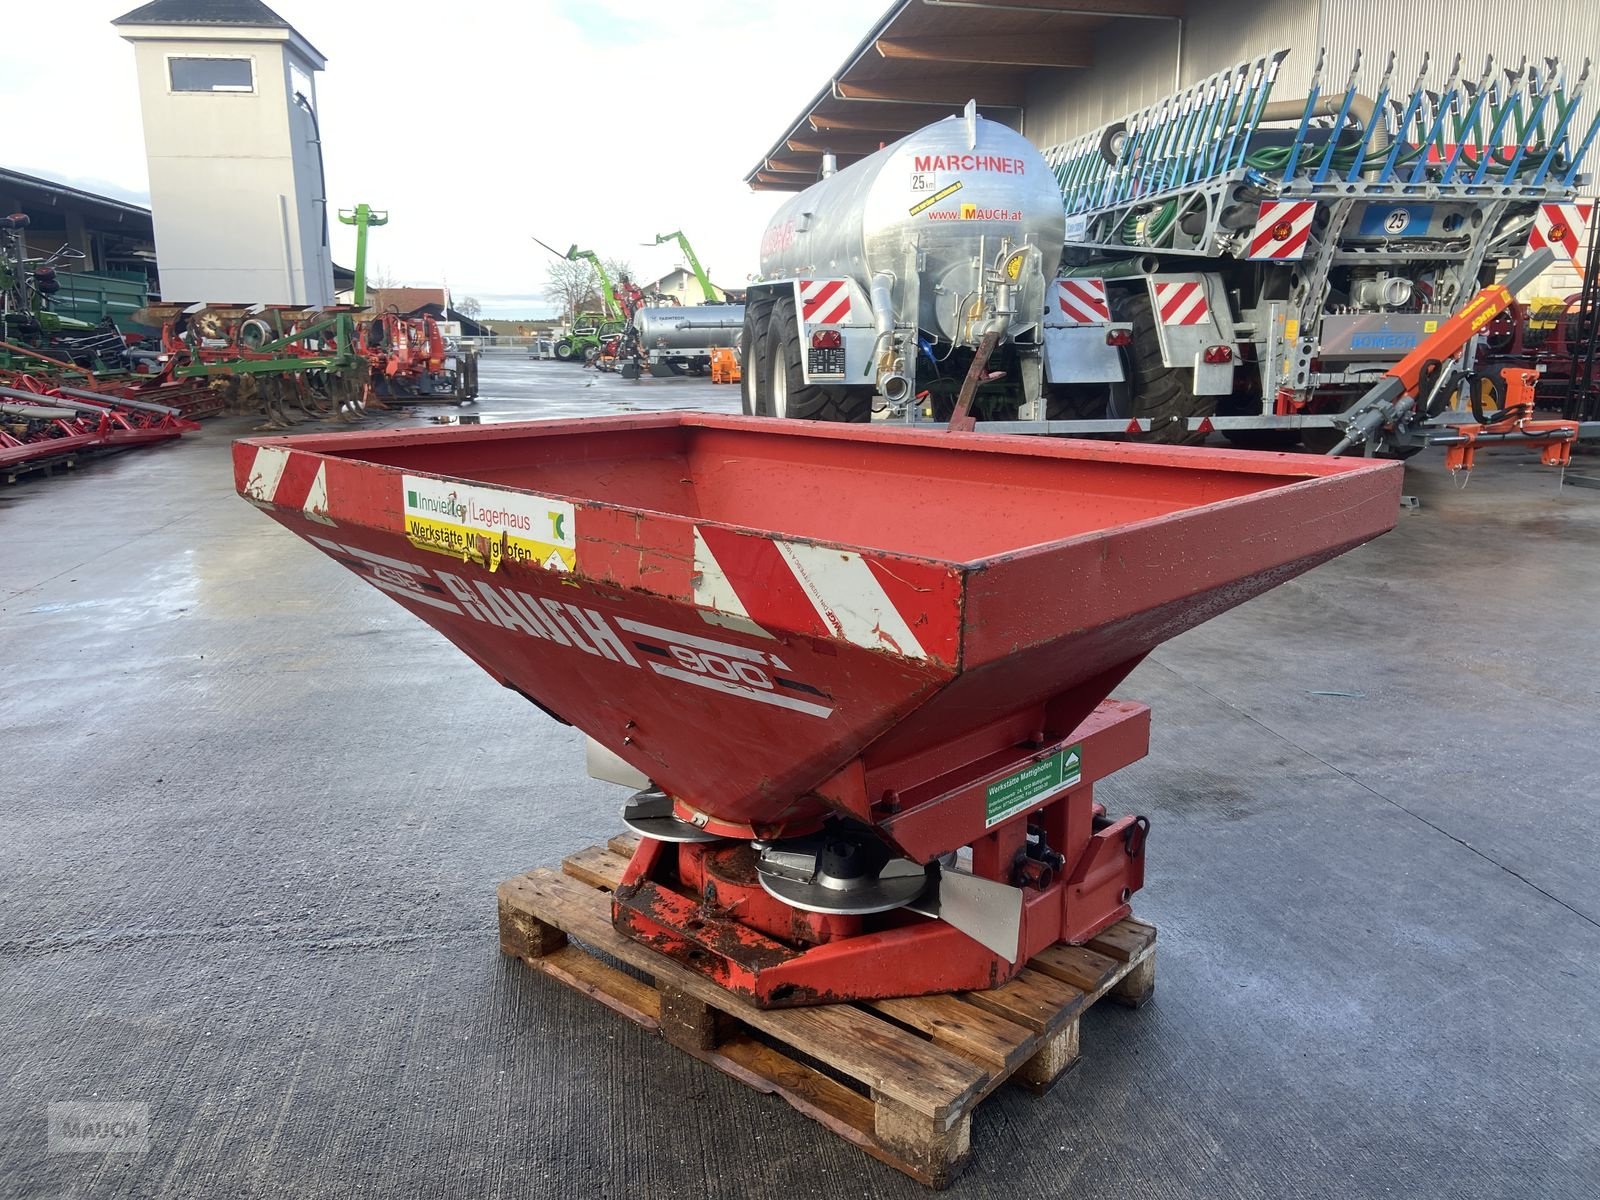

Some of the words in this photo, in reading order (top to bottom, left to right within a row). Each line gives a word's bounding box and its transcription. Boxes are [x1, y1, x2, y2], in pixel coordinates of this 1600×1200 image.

[914, 155, 1025, 175] MARCHNER
[912, 175, 925, 190] 25
[1388, 213, 1407, 229] 25
[472, 502, 531, 531] Lagerhaus
[410, 520, 463, 546] Werkstätte
[433, 569, 642, 669] RAUCH
[669, 645, 774, 689] 900
